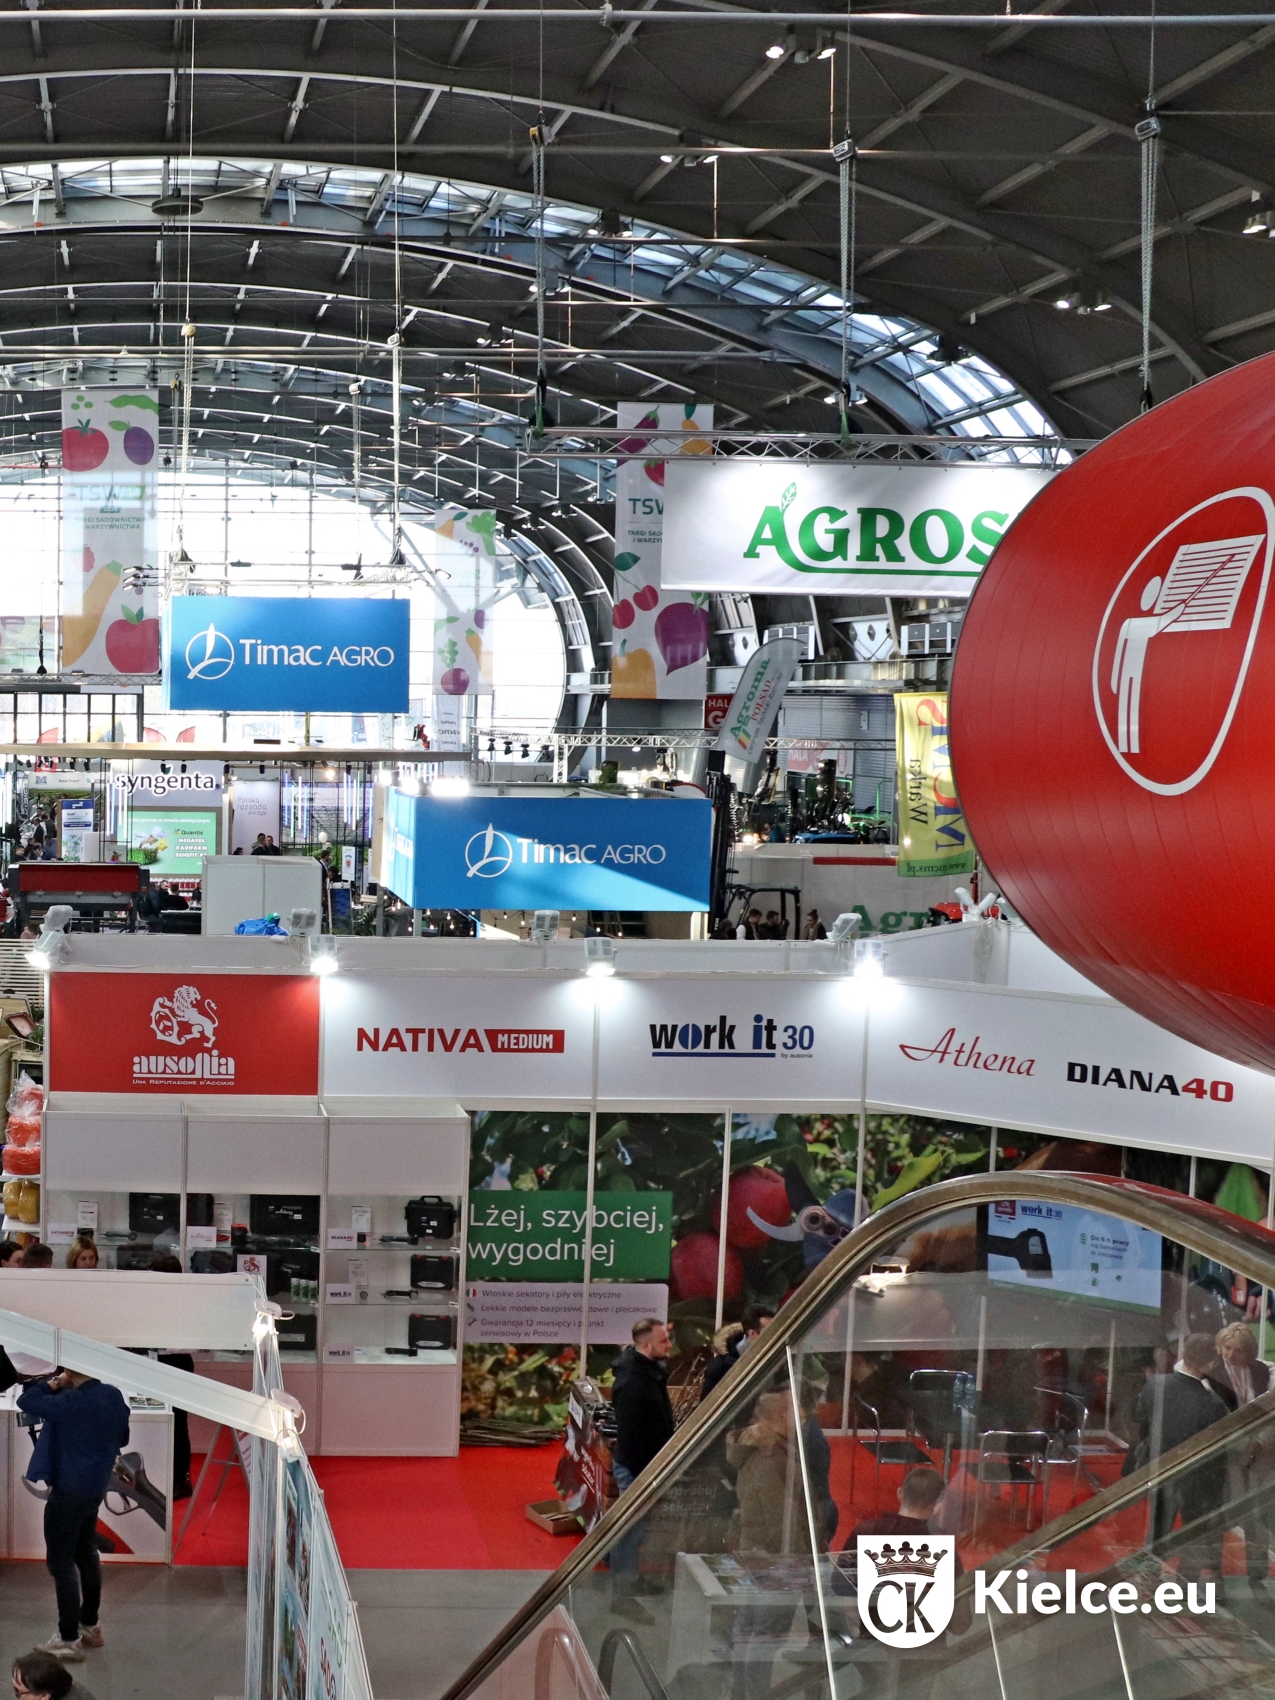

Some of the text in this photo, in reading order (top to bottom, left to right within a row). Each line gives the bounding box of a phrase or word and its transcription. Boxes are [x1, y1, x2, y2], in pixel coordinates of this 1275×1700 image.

[743, 505, 1009, 565] AGROS
[239, 638, 394, 667] Timac AGRO
[708, 699, 730, 707] HAL
[730, 658, 771, 738] Agroma
[751, 680, 772, 721] POLSAD
[708, 711, 726, 728] G
[116, 773, 214, 795] syngenta
[237, 803, 267, 811] rozsada
[517, 838, 665, 865] Timac AGRO
[851, 905, 930, 934] Agr
[356, 1028, 554, 1052] NATIVA MEDIUM
[650, 1014, 814, 1050] work it 30
[899, 1028, 1036, 1076] Athena
[470, 1204, 664, 1234] Lżej, szybciej,
[1020, 1205, 1042, 1216] work
[1046, 1206, 1052, 1217] it
[1053, 1210, 1062, 1218] 30
[467, 1238, 615, 1267] wygodniej
[1112, 1239, 1129, 1247] pracy
[482, 1290, 514, 1298] Włoskie
[516, 1290, 550, 1299] sekatory
[556, 1290, 570, 1300] piły
[509, 1305, 538, 1313] modele
[615, 1306, 657, 1314] plecakowe
[480, 1319, 523, 1328] Gwarancja
[536, 1319, 571, 1329] miesięcy
[480, 1330, 521, 1338] serwisowy
